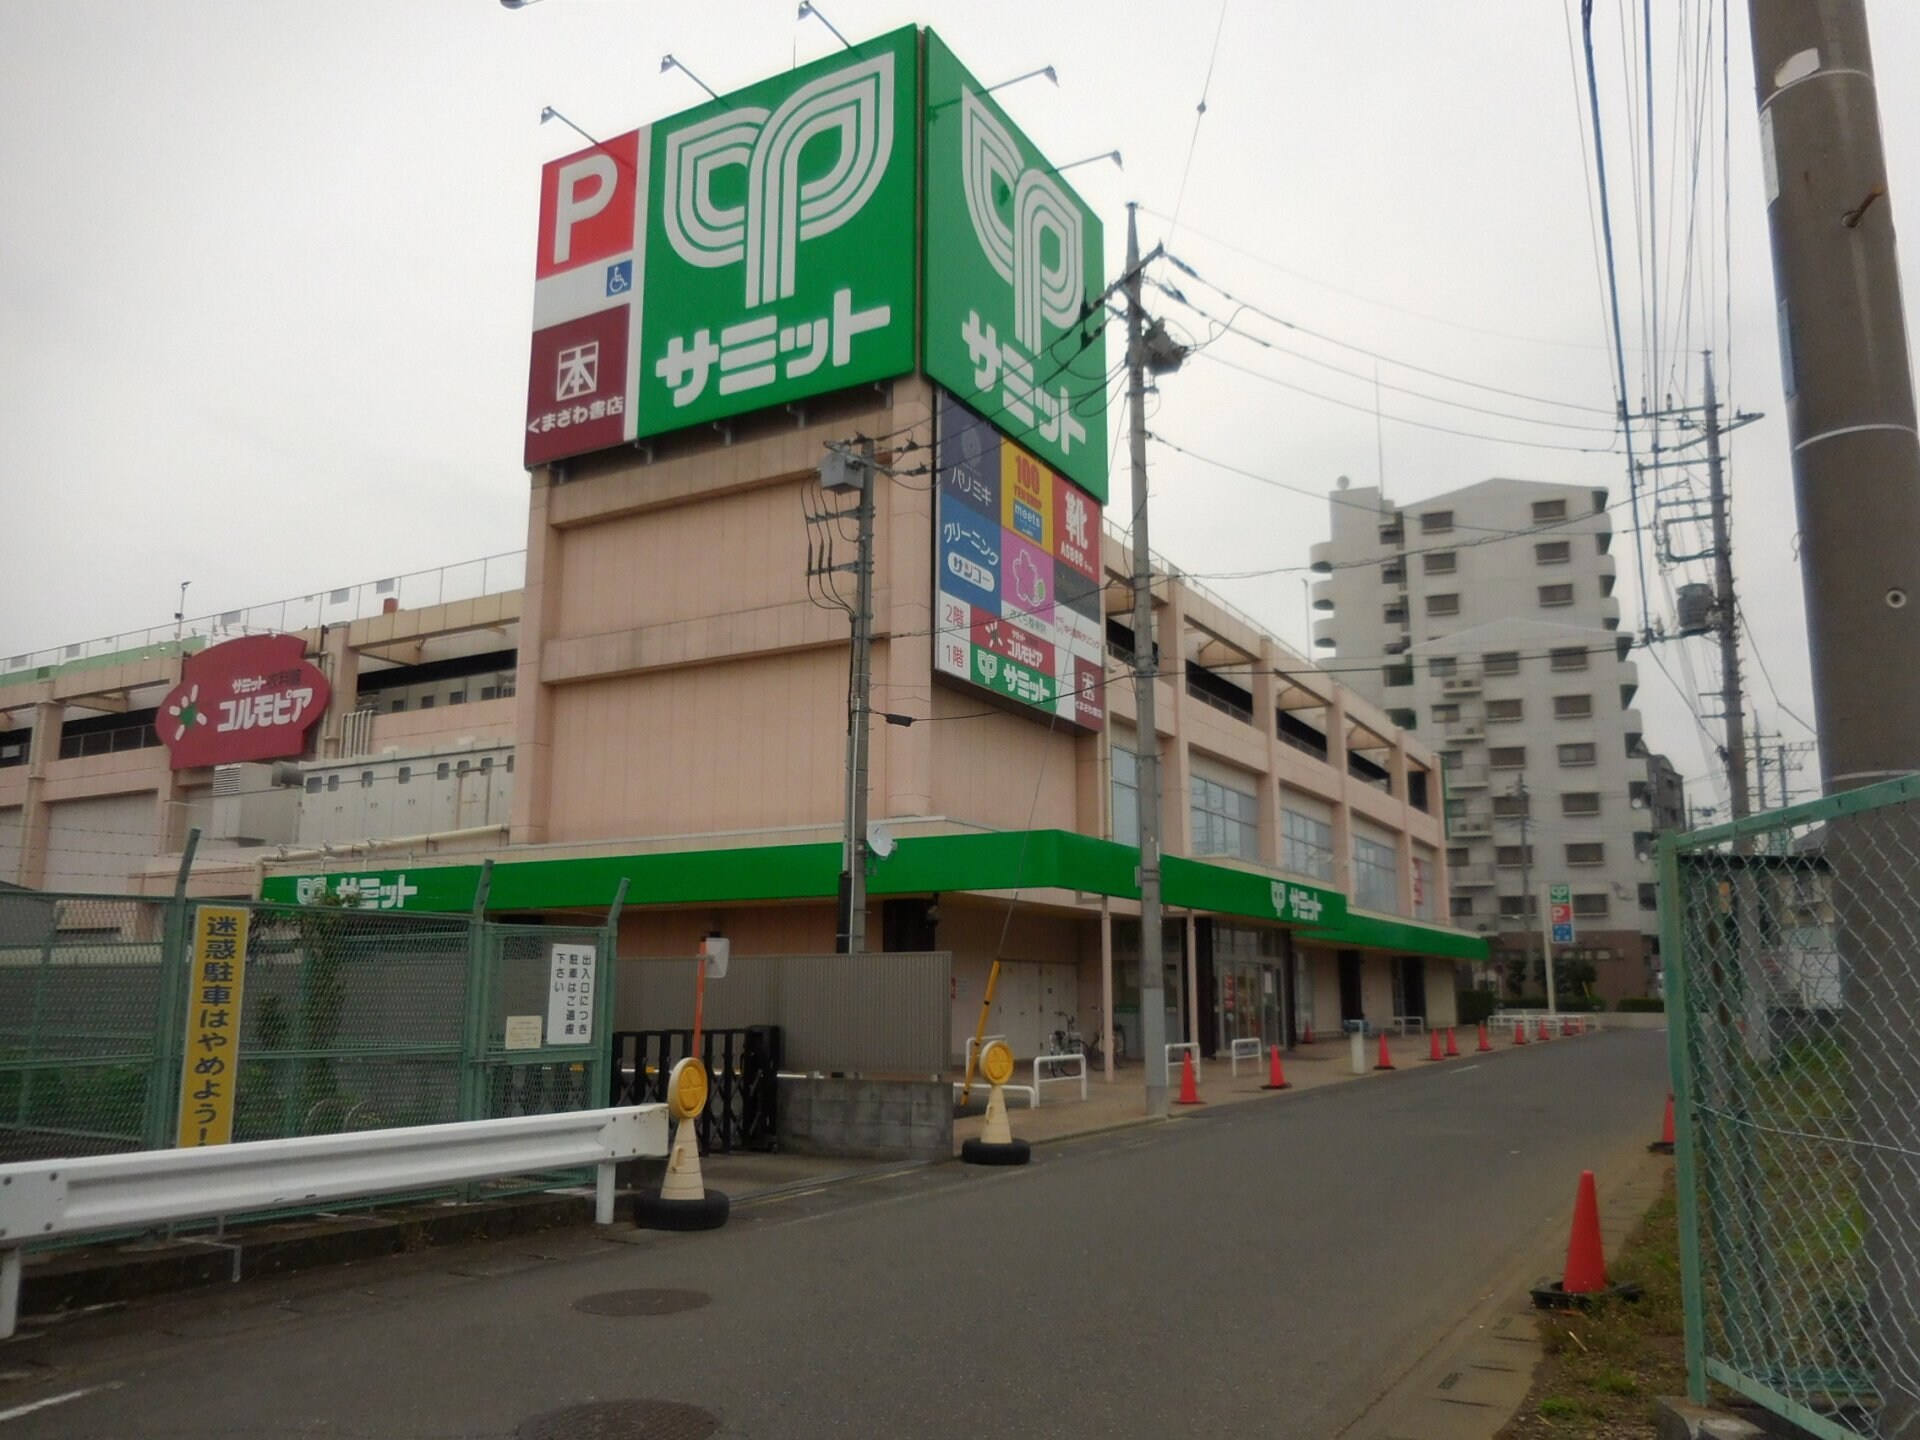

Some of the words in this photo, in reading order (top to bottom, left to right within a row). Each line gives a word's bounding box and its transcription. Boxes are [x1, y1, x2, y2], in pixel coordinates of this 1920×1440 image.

[553, 153, 618, 265] P
[655, 288, 890, 408] サミット
[962, 309, 1086, 455] サミット
[527, 396, 624, 433] くまざわ書店
[951, 466, 992, 506] パリミキ
[1015, 455, 1040, 495] 100
[1065, 491, 1088, 549] 靴
[952, 556, 991, 584] サンコー
[945, 603, 964, 629] 2階
[945, 644, 964, 668] 1階
[231, 675, 266, 694] サミット
[1003, 663, 1051, 702] サミット
[217, 688, 313, 733] コルモピア
[336, 874, 418, 909] サミット
[1289, 887, 1323, 921] サミット
[554, 953, 566, 993] 下さい
[578, 954, 592, 1035] 出入口につき
